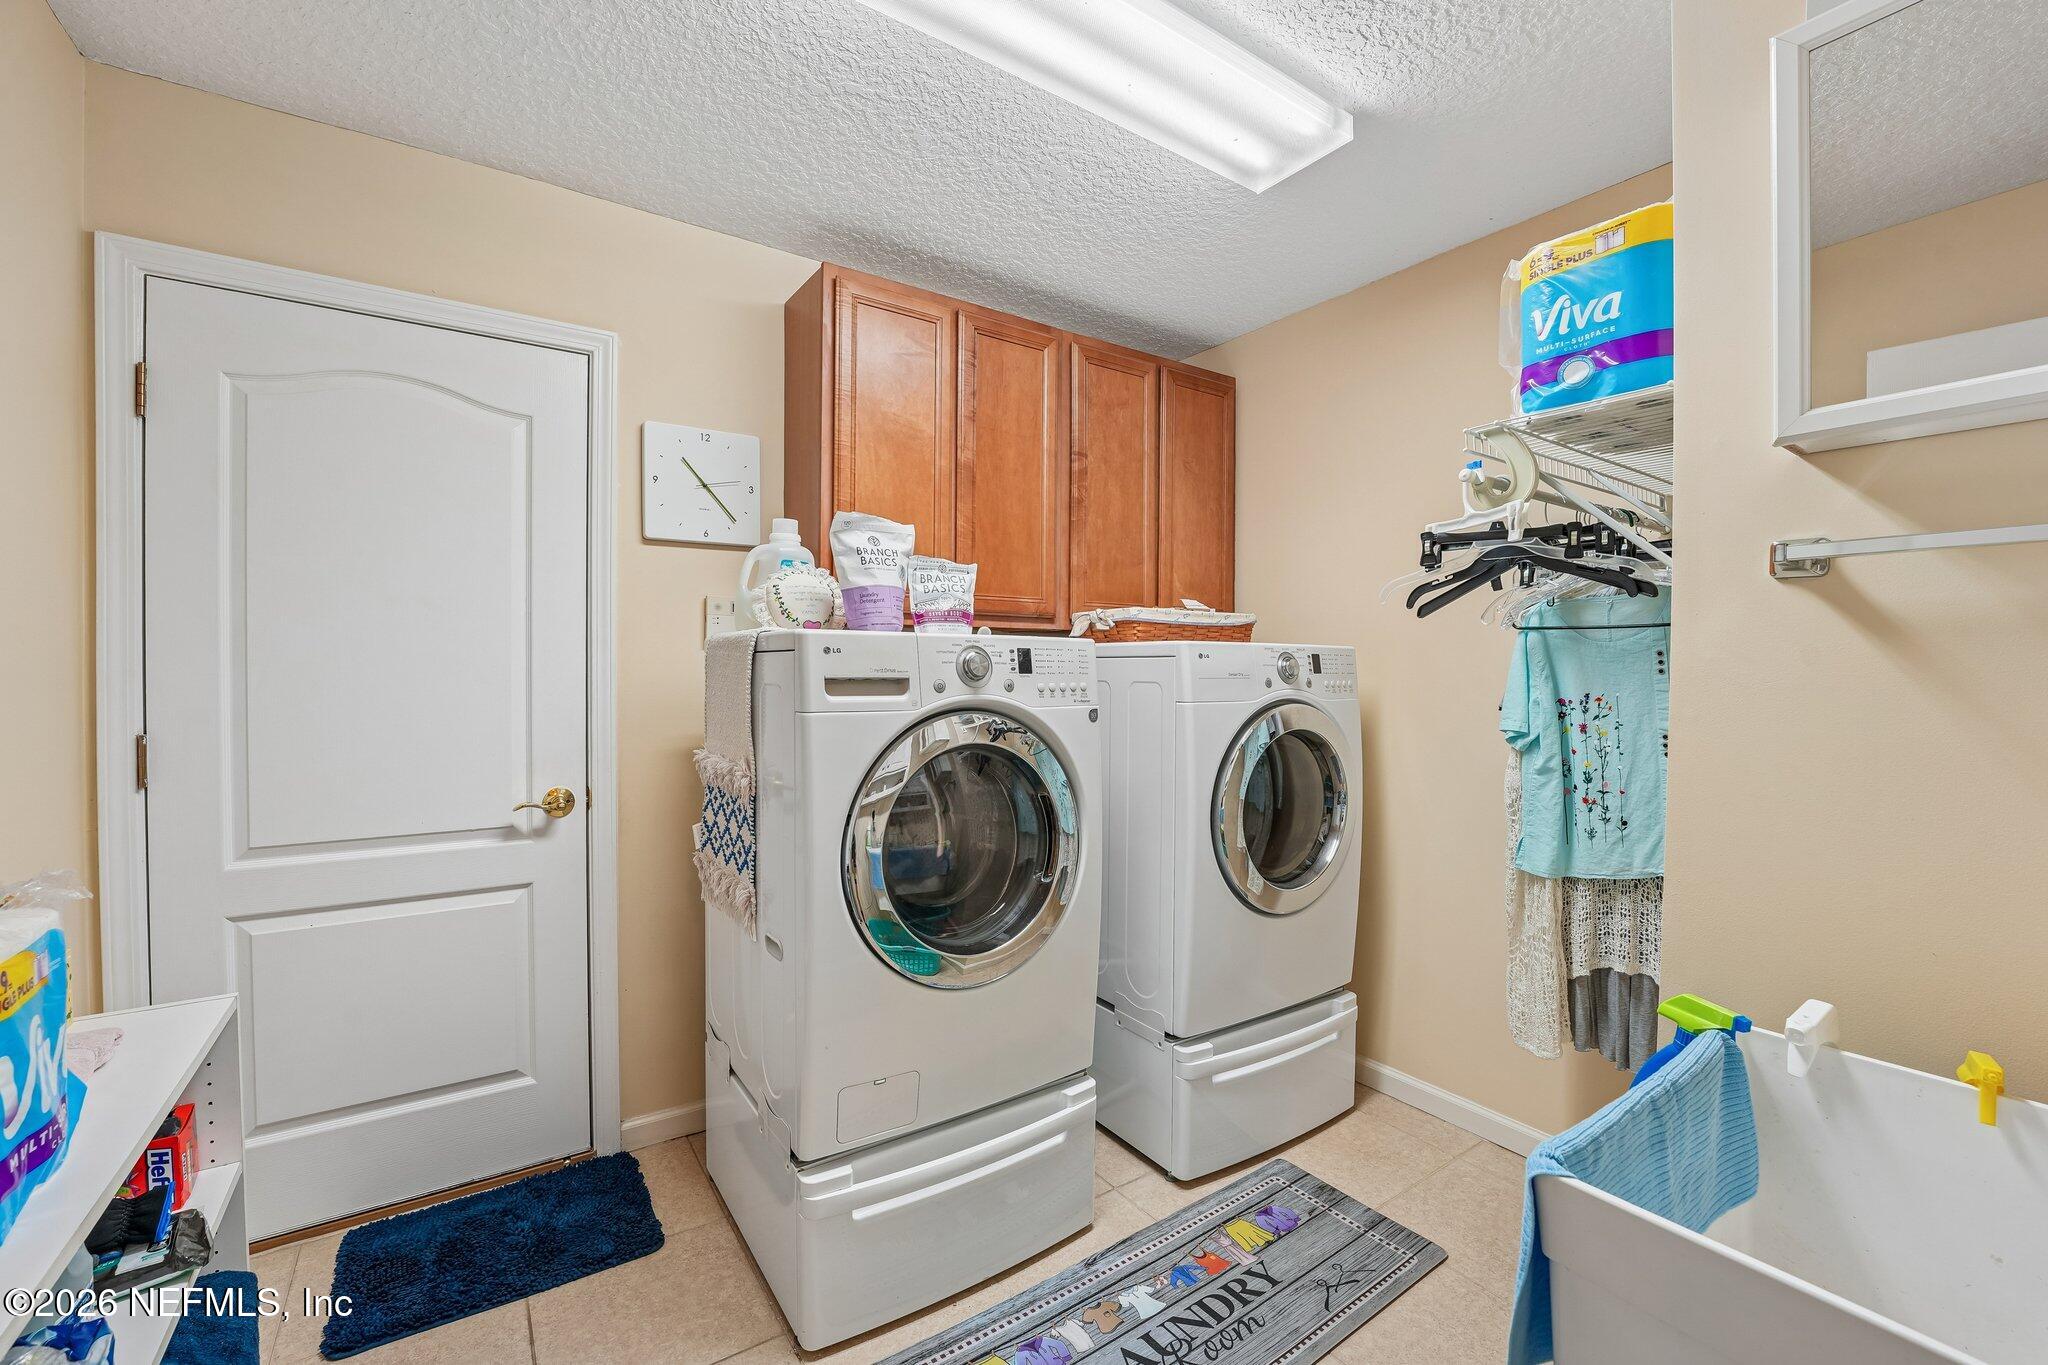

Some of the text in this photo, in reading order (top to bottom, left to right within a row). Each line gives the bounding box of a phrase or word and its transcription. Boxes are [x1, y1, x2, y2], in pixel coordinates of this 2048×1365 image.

[1565, 249, 1593, 266] PLUS
[1533, 290, 1622, 341] Viva
[1535, 326, 1616, 355] MULTI-SURFACE
[700, 432, 711, 442] 12
[652, 475, 659, 483] 9
[748, 486, 754, 494] 3
[703, 529, 709, 537] 6
[856, 546, 899, 557] BRANCH
[860, 556, 898, 567] BASICS
[920, 573, 966, 584] BRANCH
[923, 584, 966, 594] BASICS
[150, 1151, 170, 1187] Hef
[1119, 1259, 1284, 1365] AUNDRY
